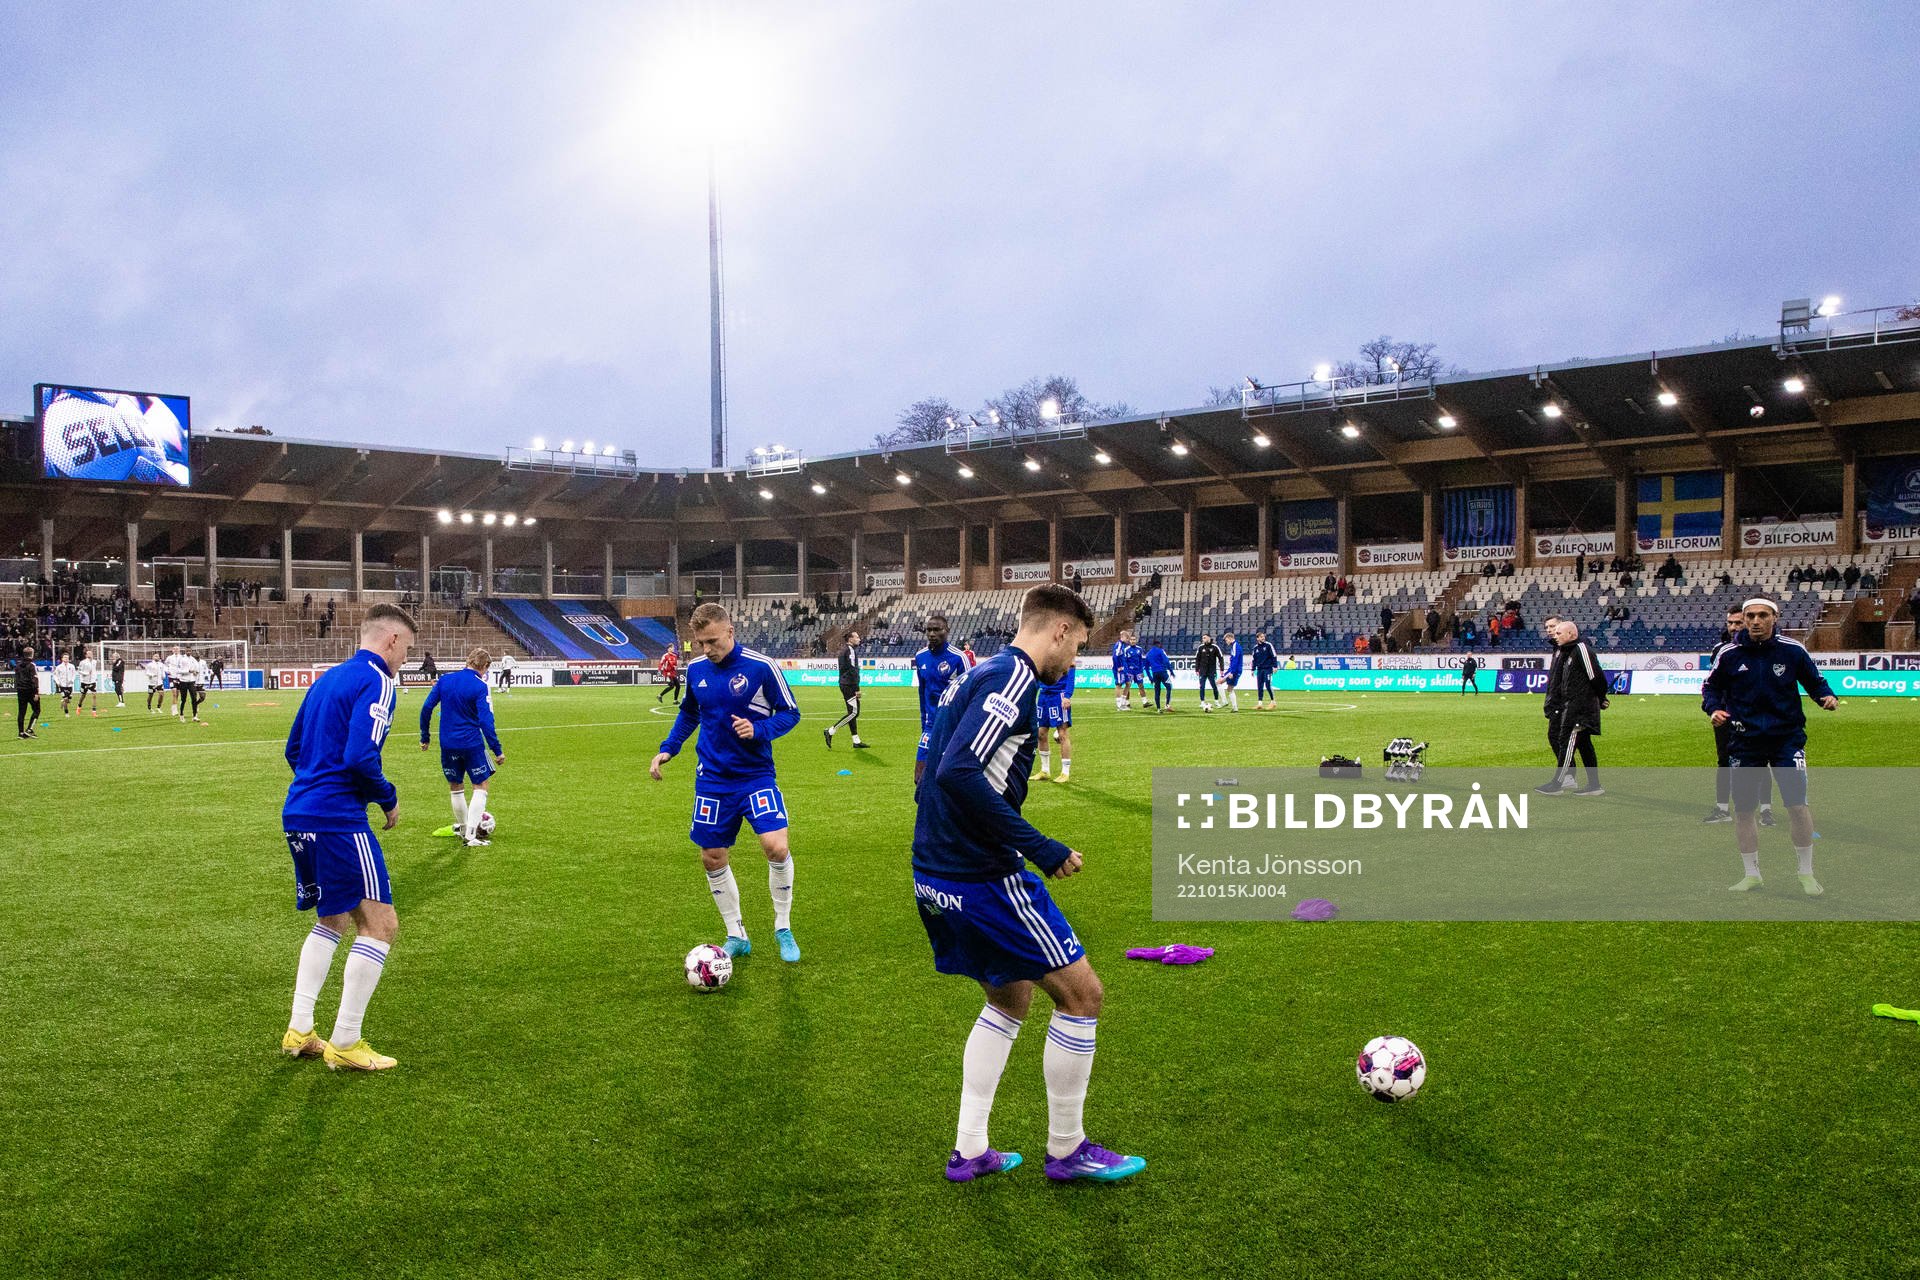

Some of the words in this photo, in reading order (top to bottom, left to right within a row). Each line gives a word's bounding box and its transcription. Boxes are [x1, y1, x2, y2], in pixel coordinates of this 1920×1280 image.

[1657, 536, 1721, 549] BILFORUM
[1764, 531, 1834, 544] BILFORUM
[1461, 547, 1514, 559] BILFORUM
[1555, 542, 1613, 554] BILFORUM
[1373, 552, 1424, 563] BILFORUM
[1141, 563, 1183, 574] BILFORUM
[1214, 560, 1258, 570] BILFORUM
[1014, 570, 1050, 580] BILFORUM
[1382, 657, 1422, 665] UPPSALA
[403, 673, 426, 681] SKIVOR
[1303, 674, 1346, 688] Omsorg
[1349, 677, 1371, 685] som
[1374, 675, 1394, 688] gör
[1397, 674, 1427, 688] riktig
[1842, 675, 1907, 692] Omsorg
[989, 697, 1017, 719] UNIBET
